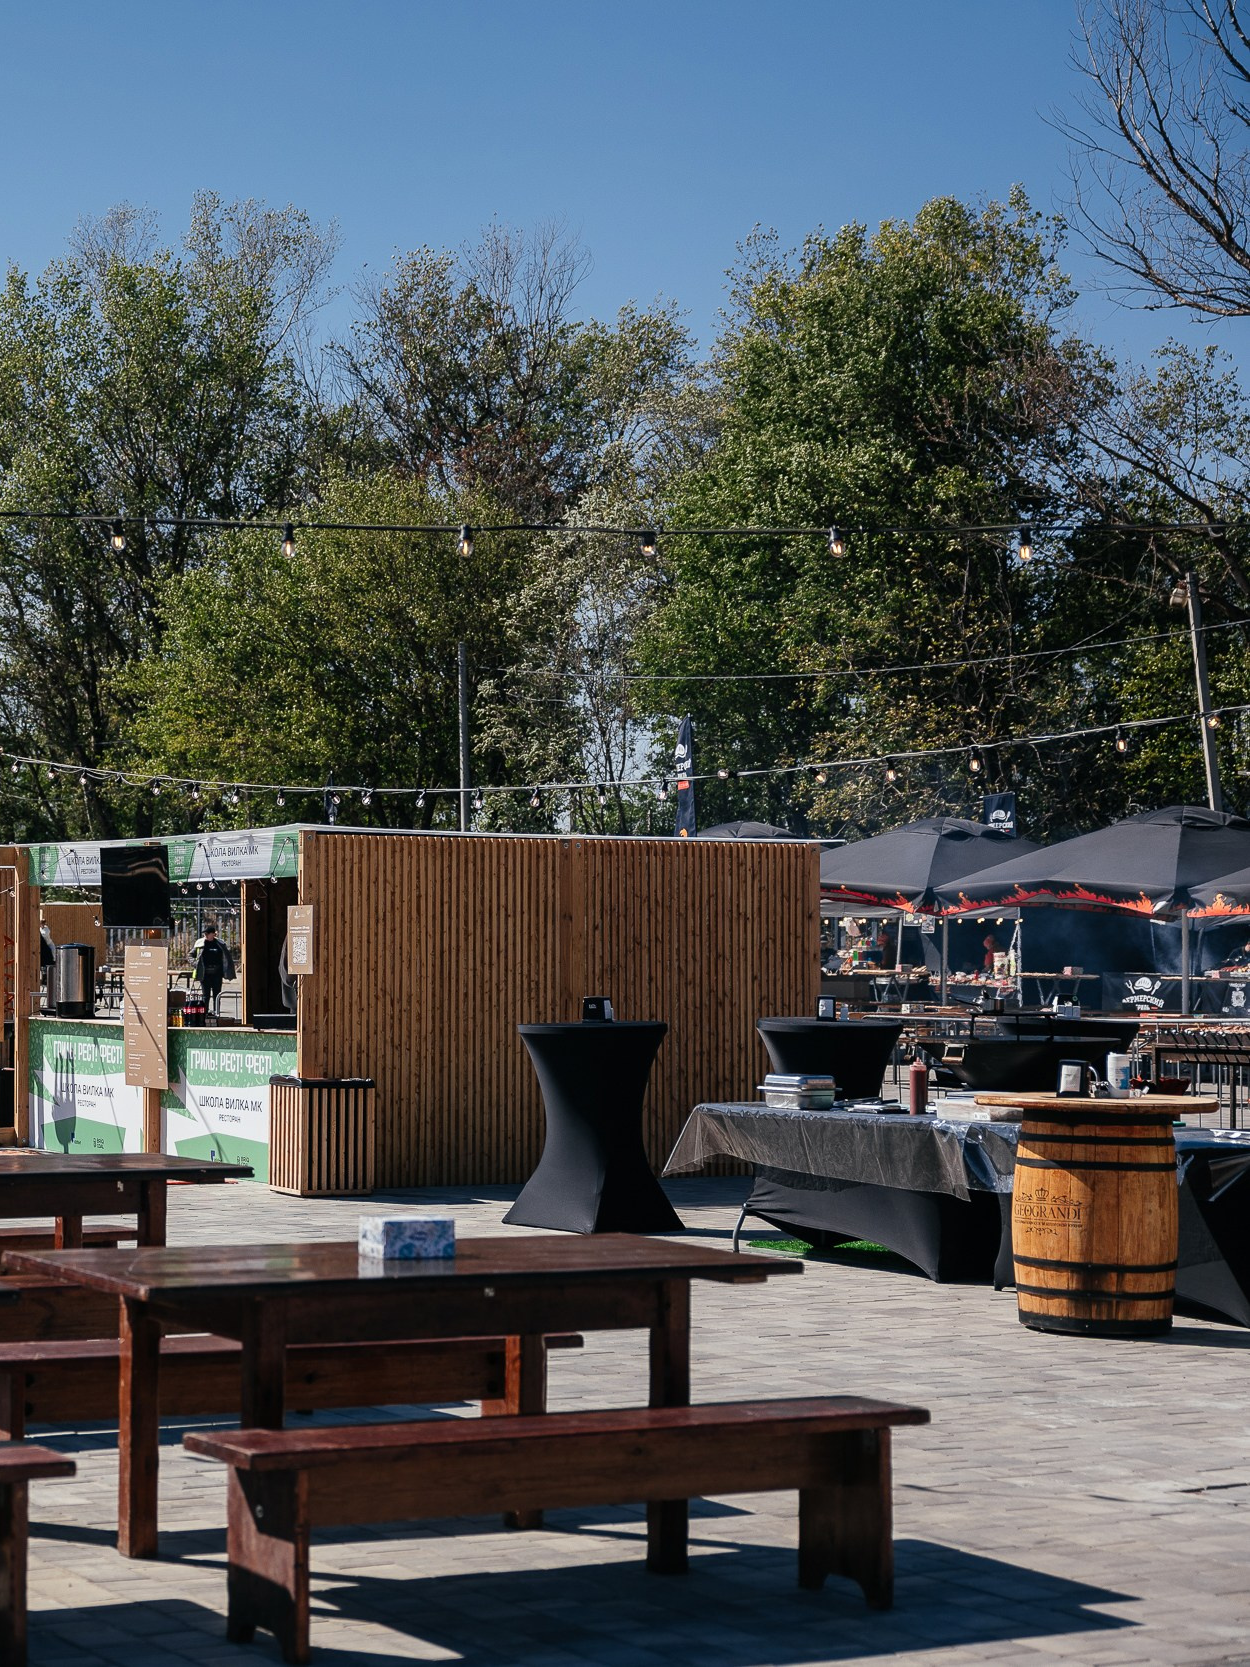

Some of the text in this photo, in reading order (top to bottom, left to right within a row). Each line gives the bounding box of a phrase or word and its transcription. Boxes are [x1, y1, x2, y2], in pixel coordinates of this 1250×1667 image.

[227, 846, 248, 857] ВИЛКА
[86, 856, 101, 865] ВИЛК
[78, 1043, 98, 1063] РЕСТ!
[100, 1045, 123, 1064] ФЕСТ!
[190, 1051, 272, 1075] ГРИЛЬ! РЕСТ! ФЕСТ!
[61, 1083, 115, 1098] ШКОЛА ВИЛКА МК
[199, 1095, 263, 1112] ШКОЛА ВИЛКА МК
[218, 1113, 241, 1123] РЕСТОРАН
[1014, 1203, 1081, 1220] GEOGRANDI
